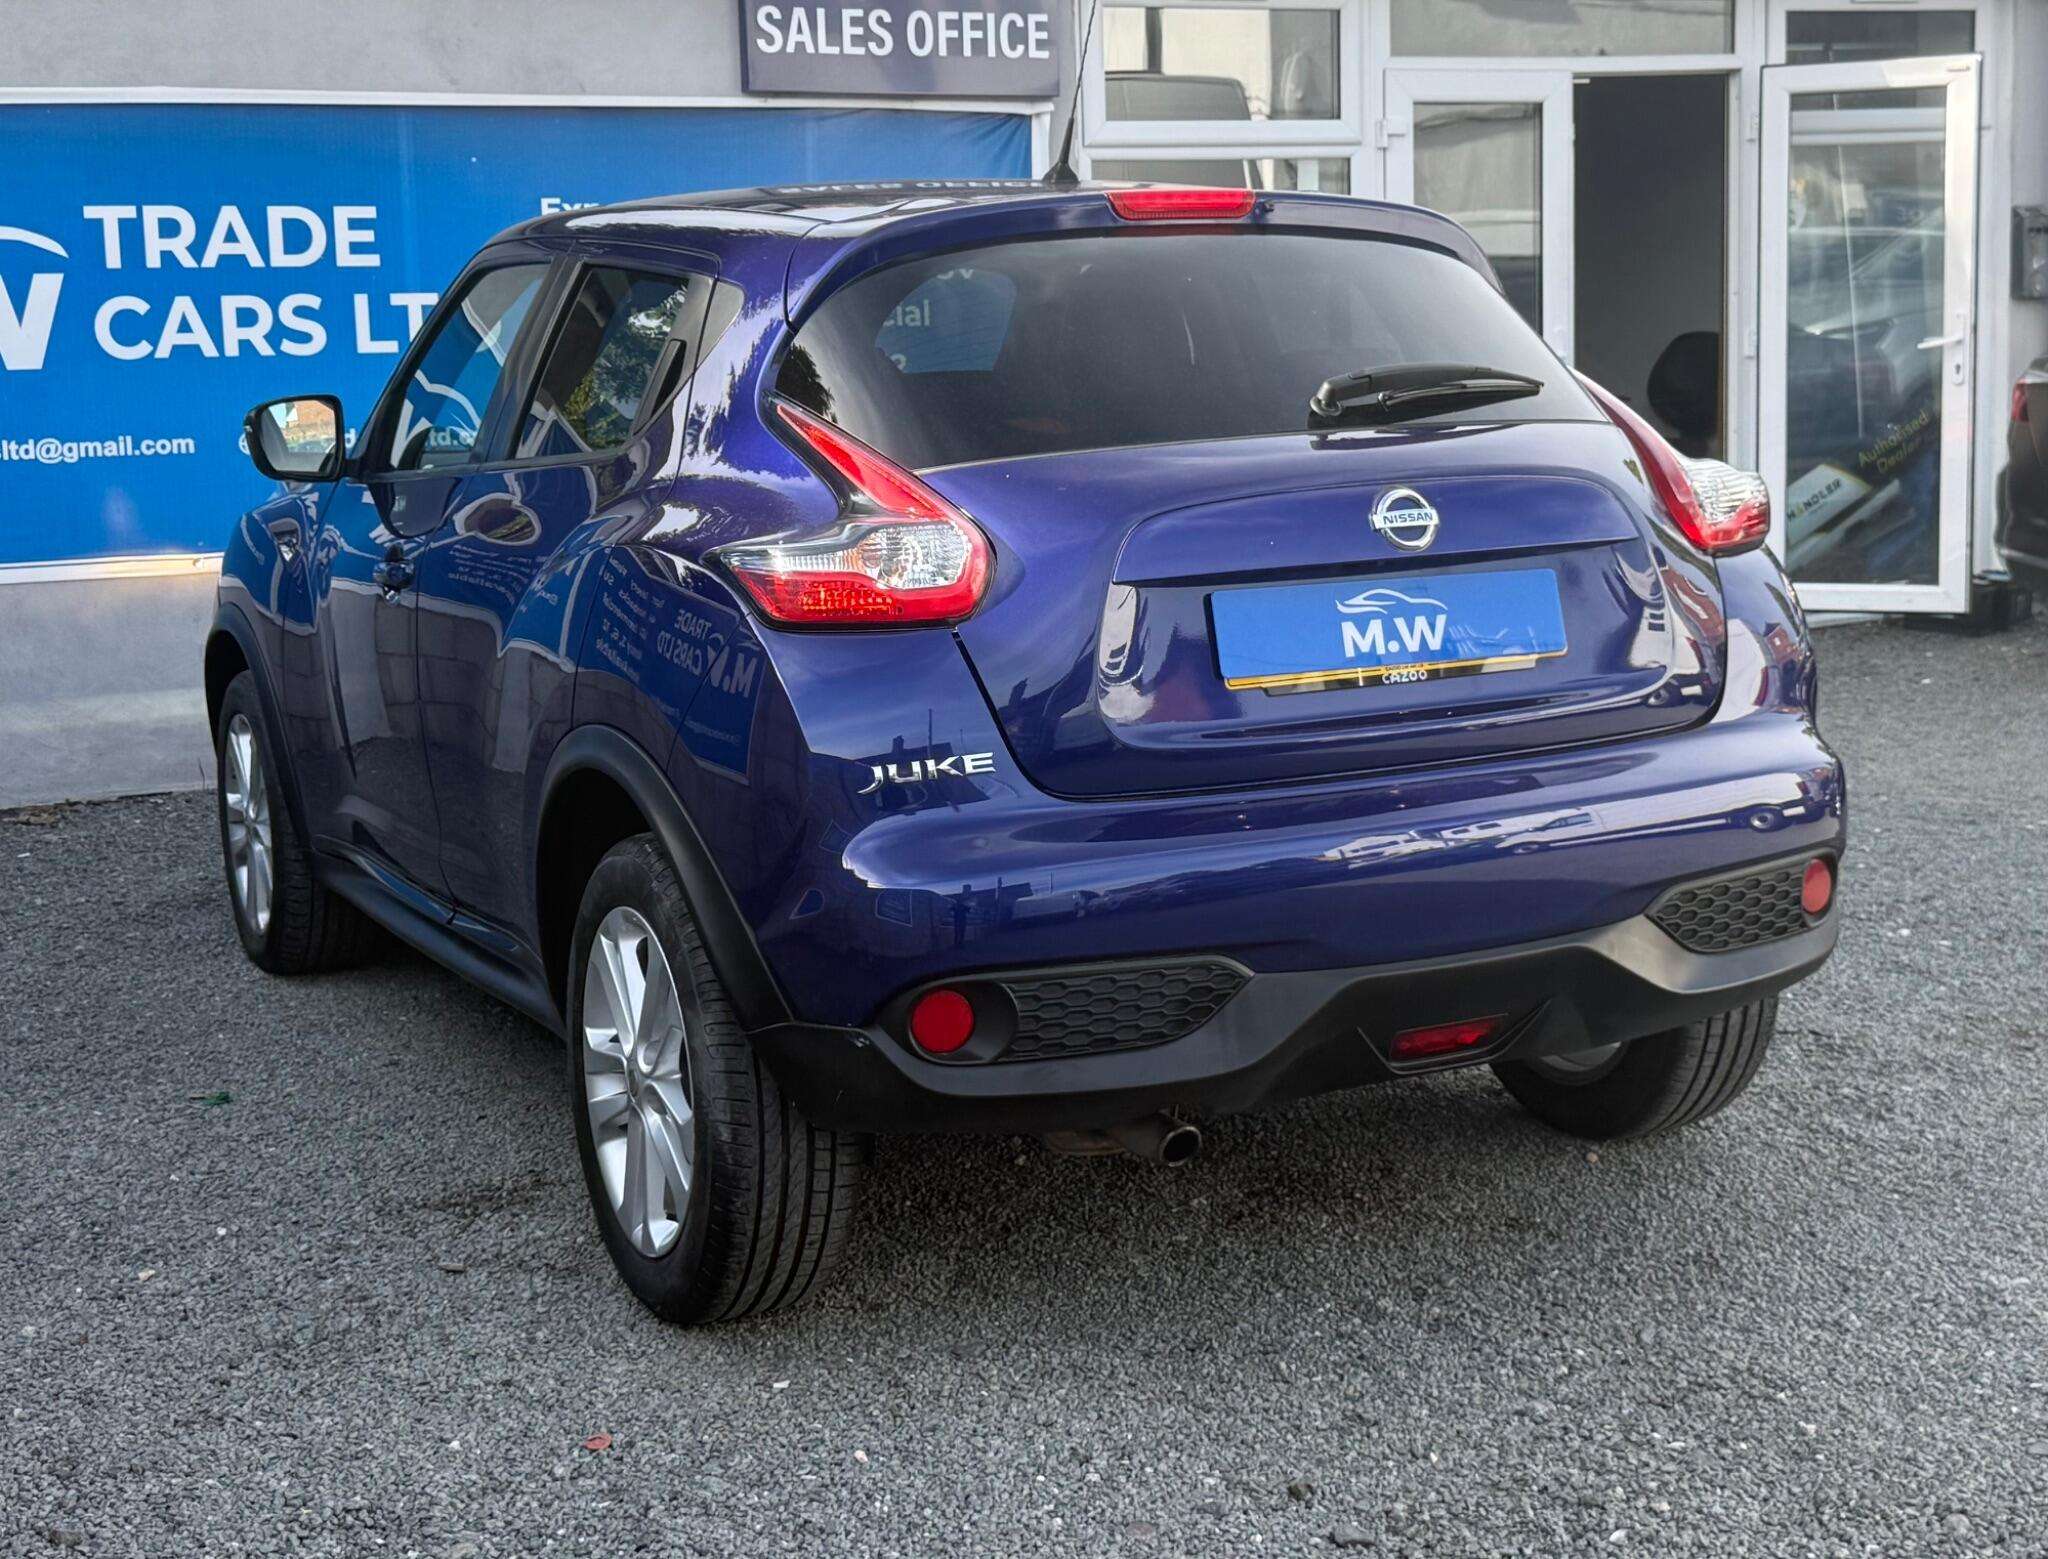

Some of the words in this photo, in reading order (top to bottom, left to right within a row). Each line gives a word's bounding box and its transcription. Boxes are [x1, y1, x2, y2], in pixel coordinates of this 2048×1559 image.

[756, 5, 894, 56] SALES
[906, 10, 1050, 59] OFFICE
[83, 205, 381, 269] TRADE
[94, 293, 328, 361] CARS
[354, 292, 440, 354] LT
[0, 435, 196, 464] ltd@gmail.com
[1383, 512, 1433, 525] NISSAN
[1341, 614, 1447, 658] M.W
[1382, 670, 1428, 684] CAZOO
[857, 752, 996, 794] JUKE
